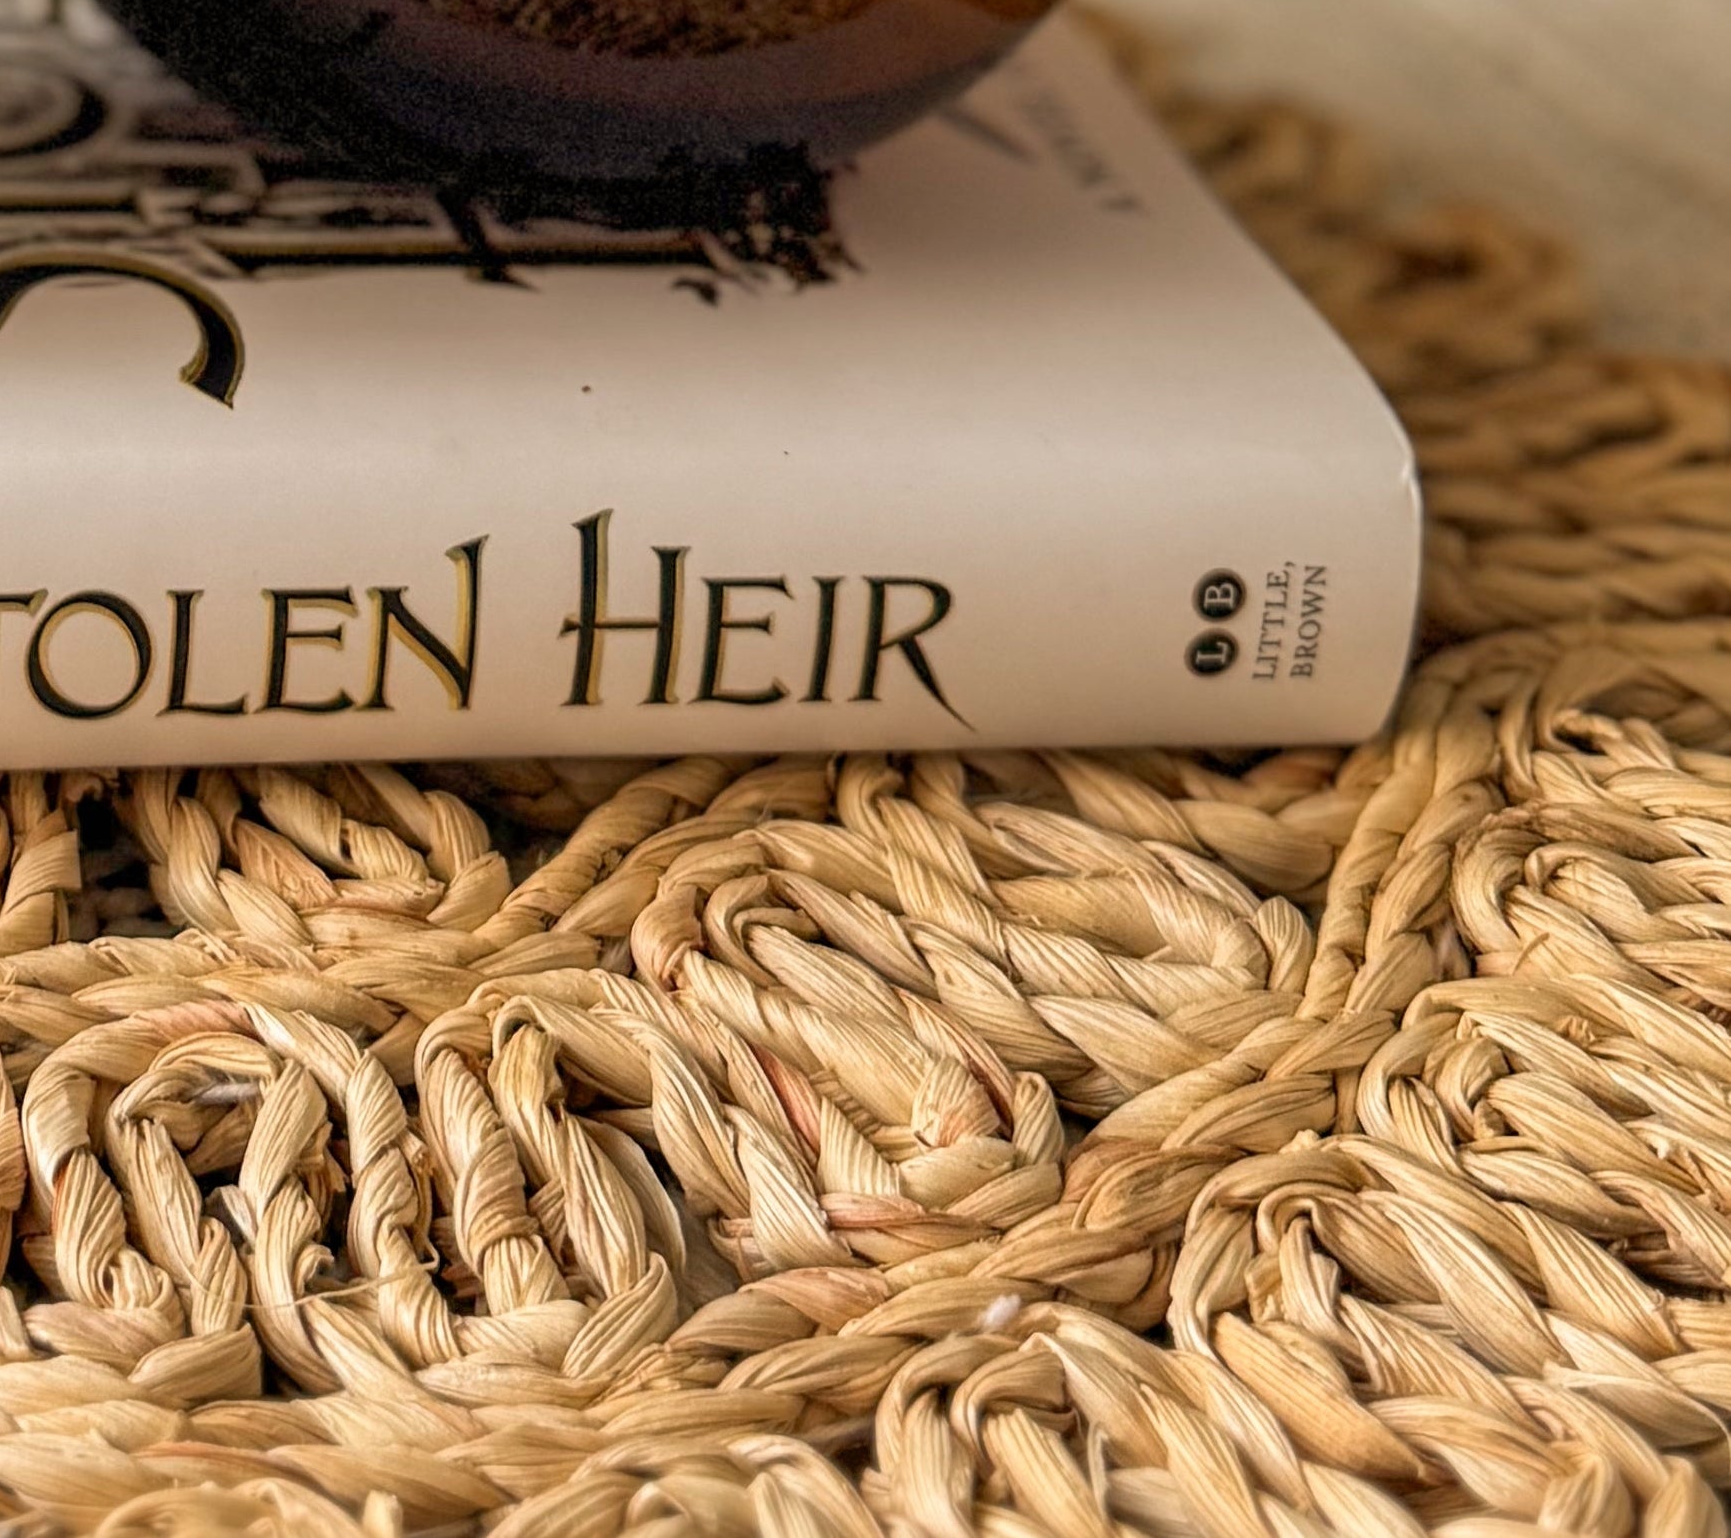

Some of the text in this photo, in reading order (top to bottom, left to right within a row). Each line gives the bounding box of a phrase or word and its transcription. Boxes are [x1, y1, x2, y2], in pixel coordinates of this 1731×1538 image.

[557, 507, 979, 733] HEIR
[1252, 560, 1297, 681] LITTLE,
[1289, 564, 1328, 678] BROWN
